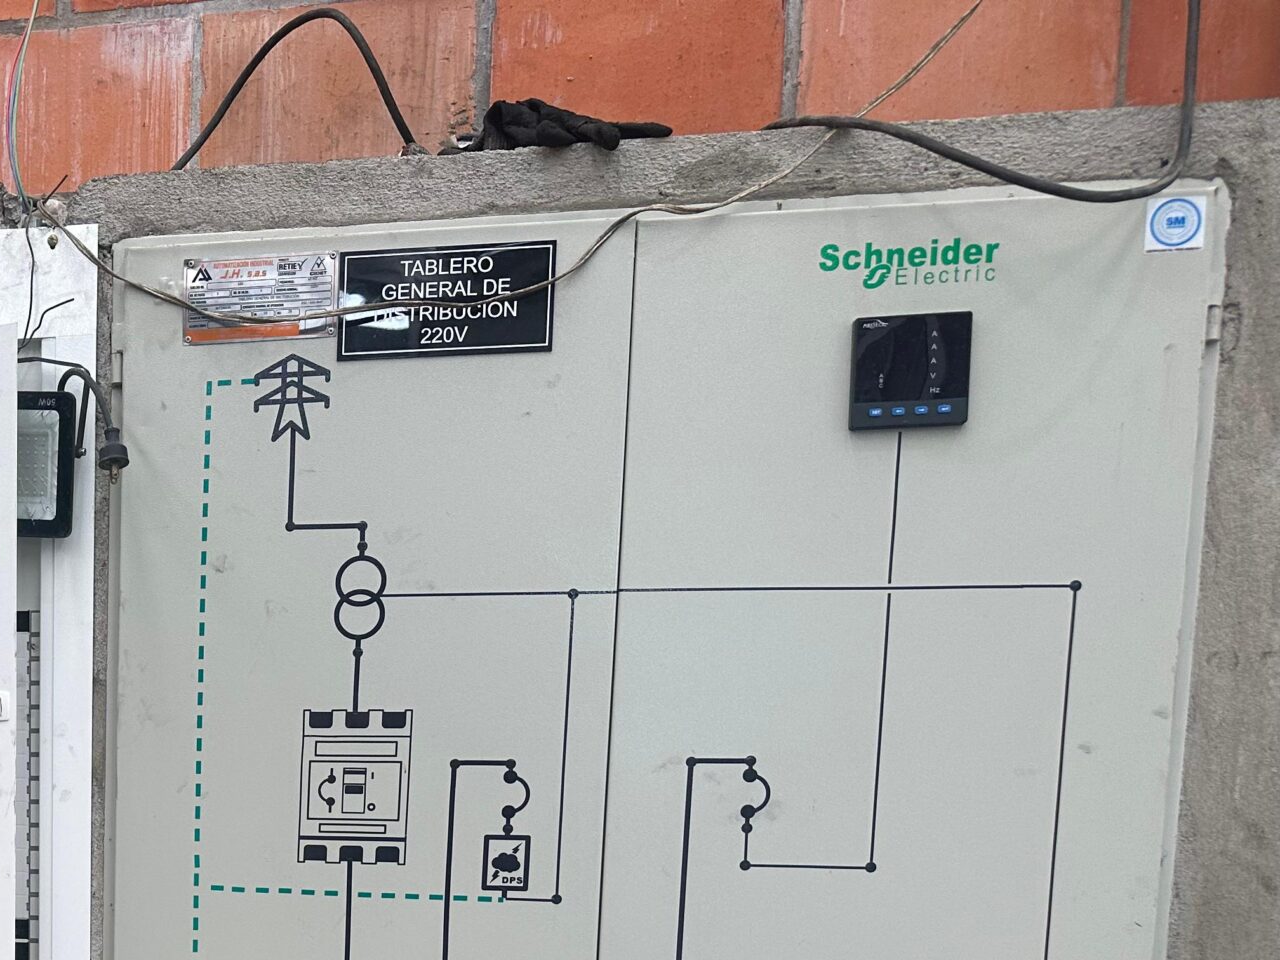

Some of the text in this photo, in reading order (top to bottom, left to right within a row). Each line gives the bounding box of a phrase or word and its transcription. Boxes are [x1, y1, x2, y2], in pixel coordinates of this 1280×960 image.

[819, 238, 1000, 272] Schneider
[400, 256, 493, 277] TABLERO
[895, 265, 996, 285] Electric
[382, 278, 511, 300] GENERAL DE
[420, 326, 469, 344] 220V
[502, 876, 523, 884] DPS
